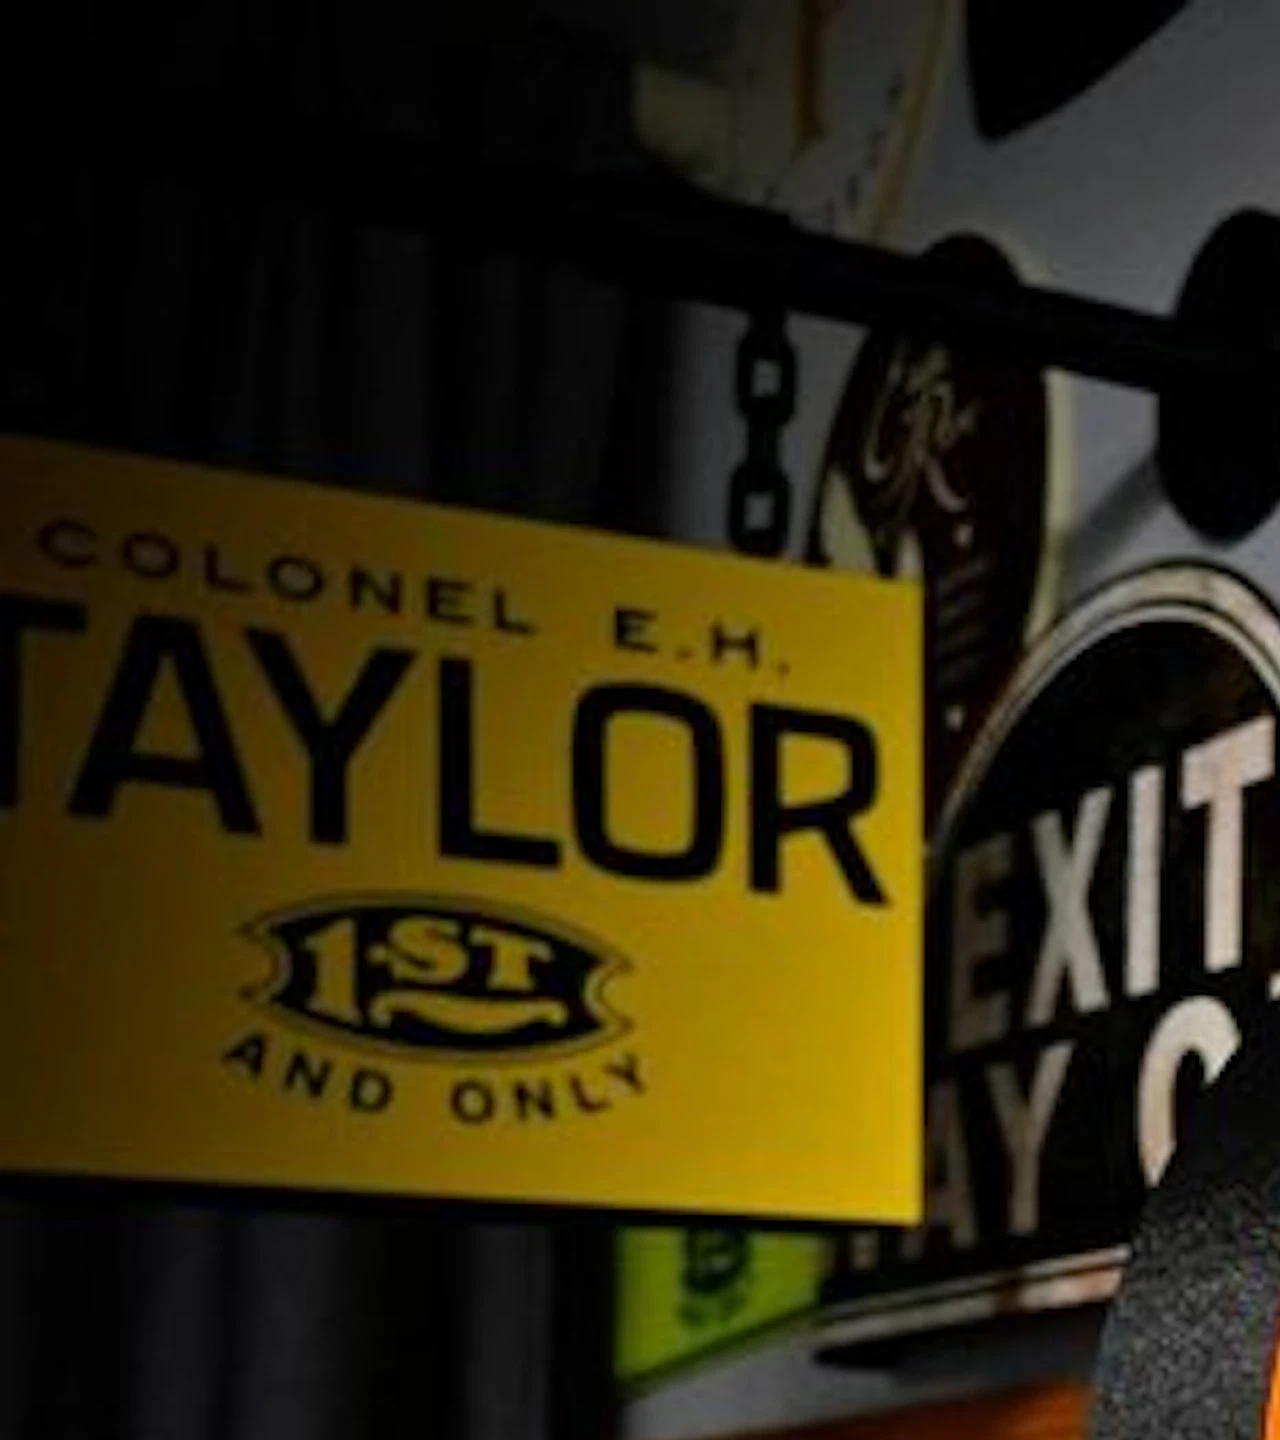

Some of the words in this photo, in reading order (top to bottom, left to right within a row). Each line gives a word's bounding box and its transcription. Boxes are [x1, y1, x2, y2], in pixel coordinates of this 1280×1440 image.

[36, 518, 537, 637] COLONEL
[615, 607, 791, 677] E.H.
[0, 593, 889, 907] TAYLOR
[947, 713, 1277, 1056] EXIT
[222, 1034, 393, 1112] AND
[452, 1050, 646, 1124] ONLY
[862, 1038, 1078, 1270] AY
